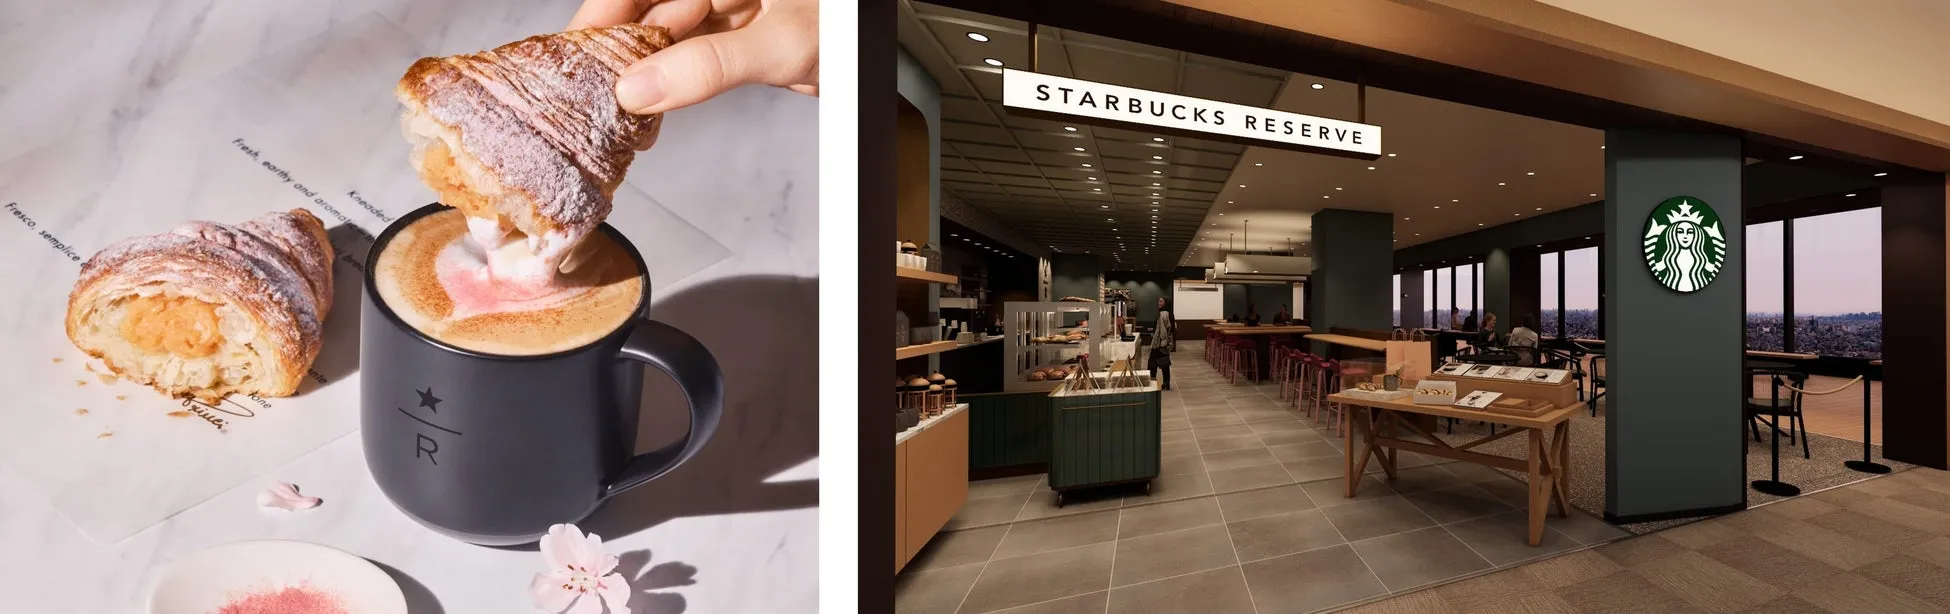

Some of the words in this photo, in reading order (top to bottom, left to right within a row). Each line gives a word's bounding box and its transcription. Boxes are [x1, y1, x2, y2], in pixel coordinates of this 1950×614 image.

[1036, 83, 1226, 126] STARBUCKS
[1244, 114, 1364, 145] RESERVE
[262, 160, 294, 183] earthy
[293, 181, 319, 198] and
[347, 190, 395, 223] Kneaded
[38, 230, 81, 262] semplice
[416, 432, 438, 466] R
